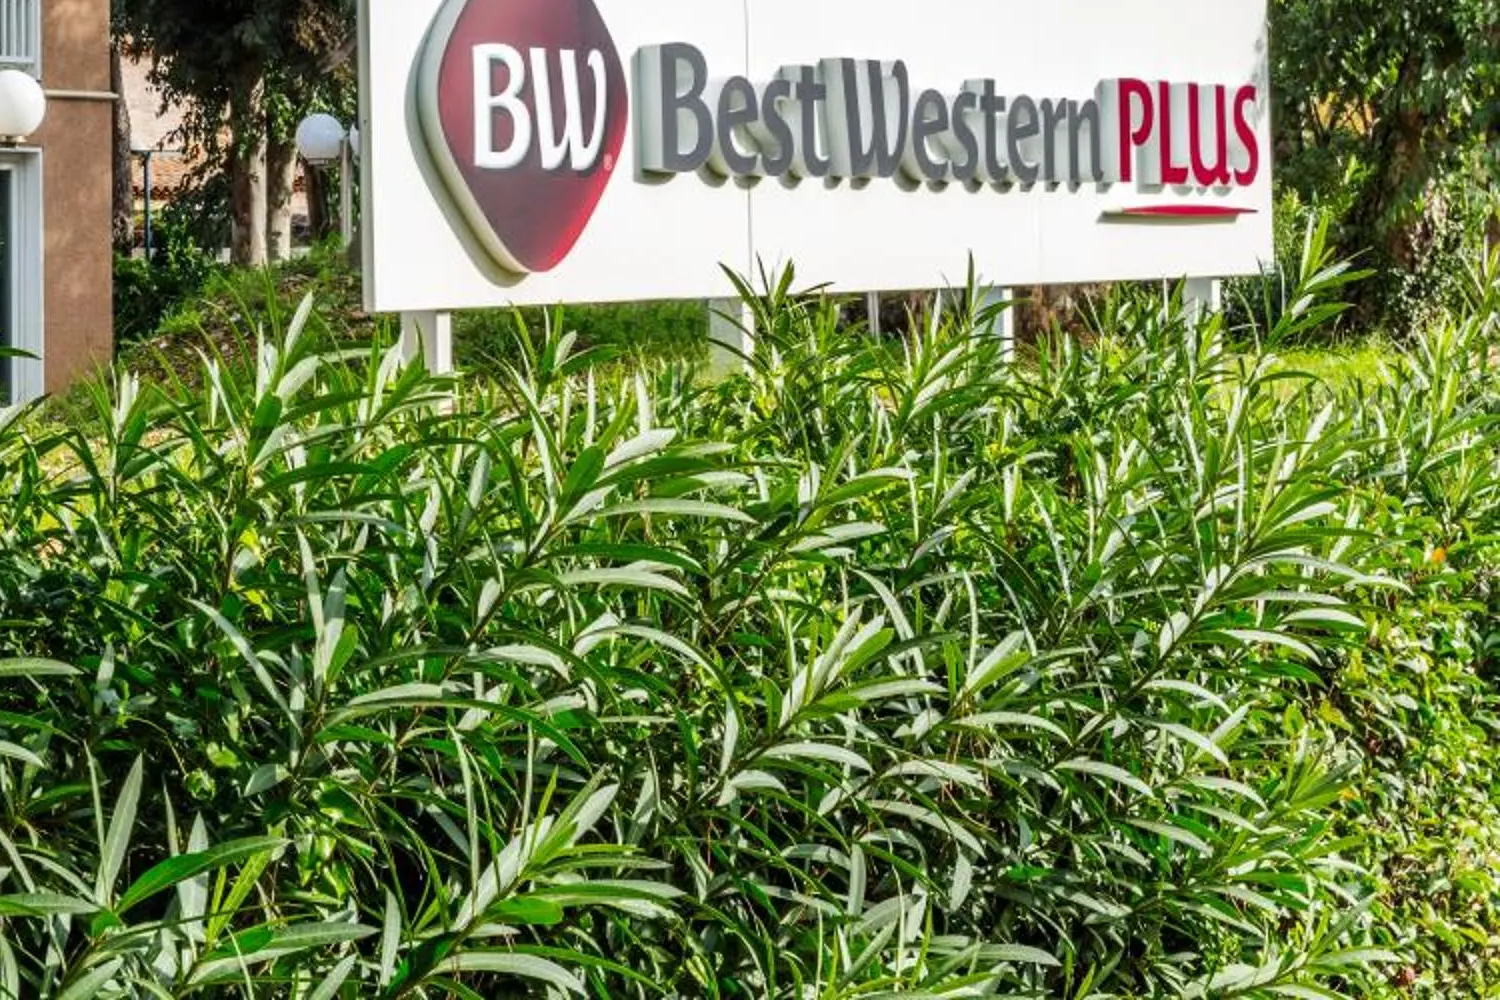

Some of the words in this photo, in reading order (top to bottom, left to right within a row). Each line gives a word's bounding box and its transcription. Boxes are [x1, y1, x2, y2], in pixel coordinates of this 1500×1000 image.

[472, 42, 607, 170] BW
[659, 42, 829, 176] Best
[841, 57, 1104, 183] Western
[1118, 78, 1258, 186] PLUS
